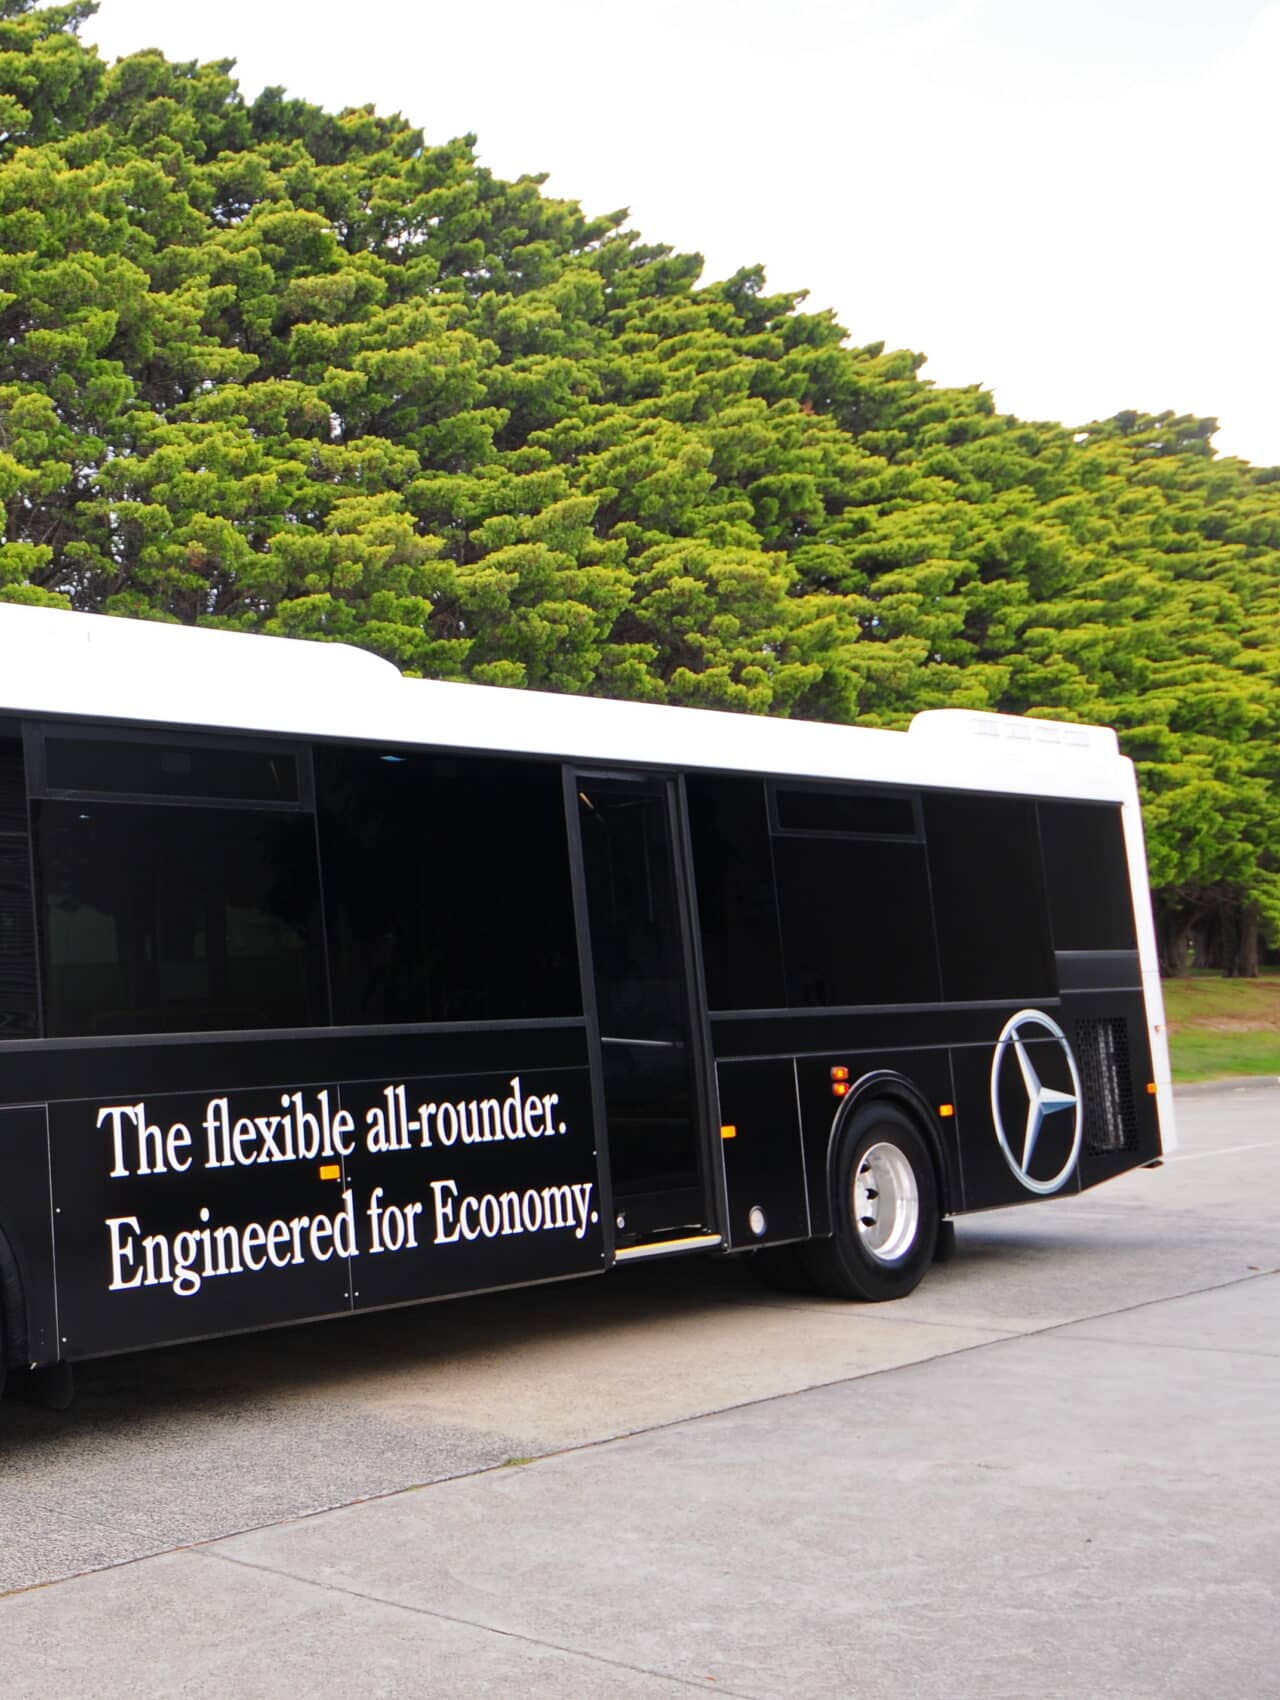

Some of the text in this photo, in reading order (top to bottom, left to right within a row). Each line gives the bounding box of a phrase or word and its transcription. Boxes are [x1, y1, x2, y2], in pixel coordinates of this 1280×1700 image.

[96, 1076, 567, 1178] The flexible all-rounder.
[105, 1179, 599, 1297] Engineered for Economy.
